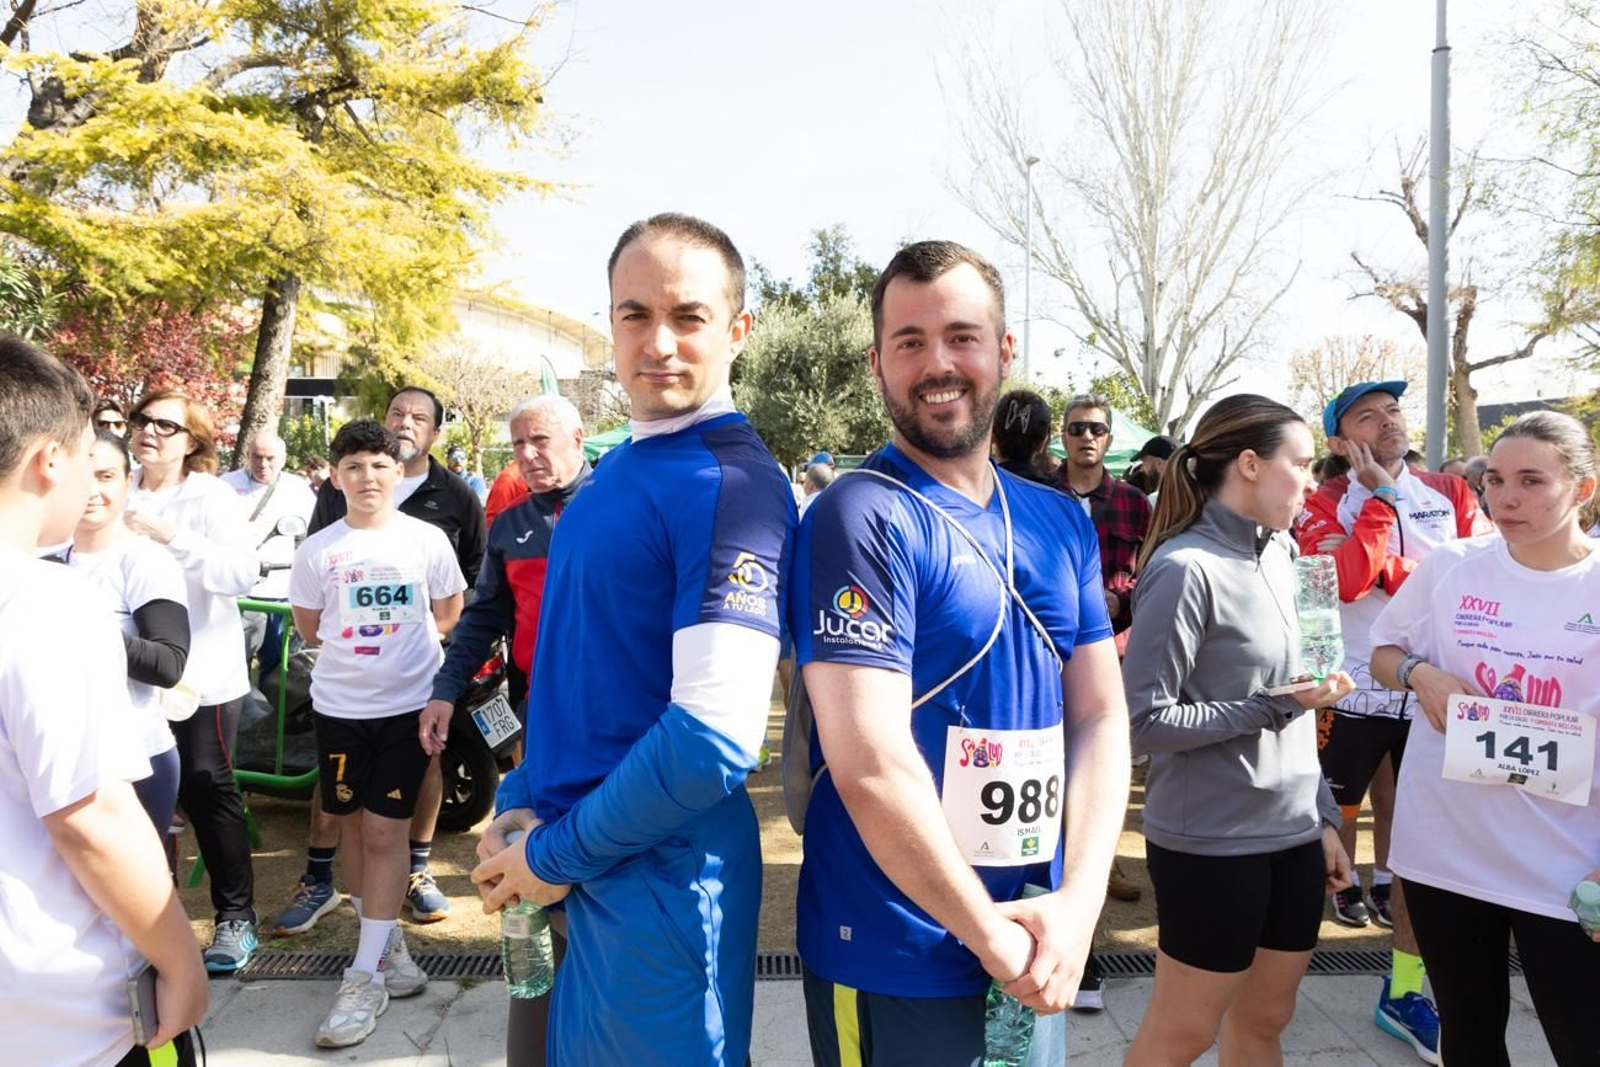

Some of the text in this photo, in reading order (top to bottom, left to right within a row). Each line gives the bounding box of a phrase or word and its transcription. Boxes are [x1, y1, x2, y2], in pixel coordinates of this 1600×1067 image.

[356, 585, 409, 607] 664
[724, 590, 766, 609] AÑOS
[1459, 594, 1501, 616] XXVII
[813, 609, 892, 643] Jucar
[482, 699, 506, 724] 1707
[492, 716, 515, 738] FRG
[1476, 730, 1558, 771] 141
[329, 753, 346, 781] 7
[1497, 763, 1541, 776] ALBA LÓPEZ
[980, 774, 1059, 825] 988
